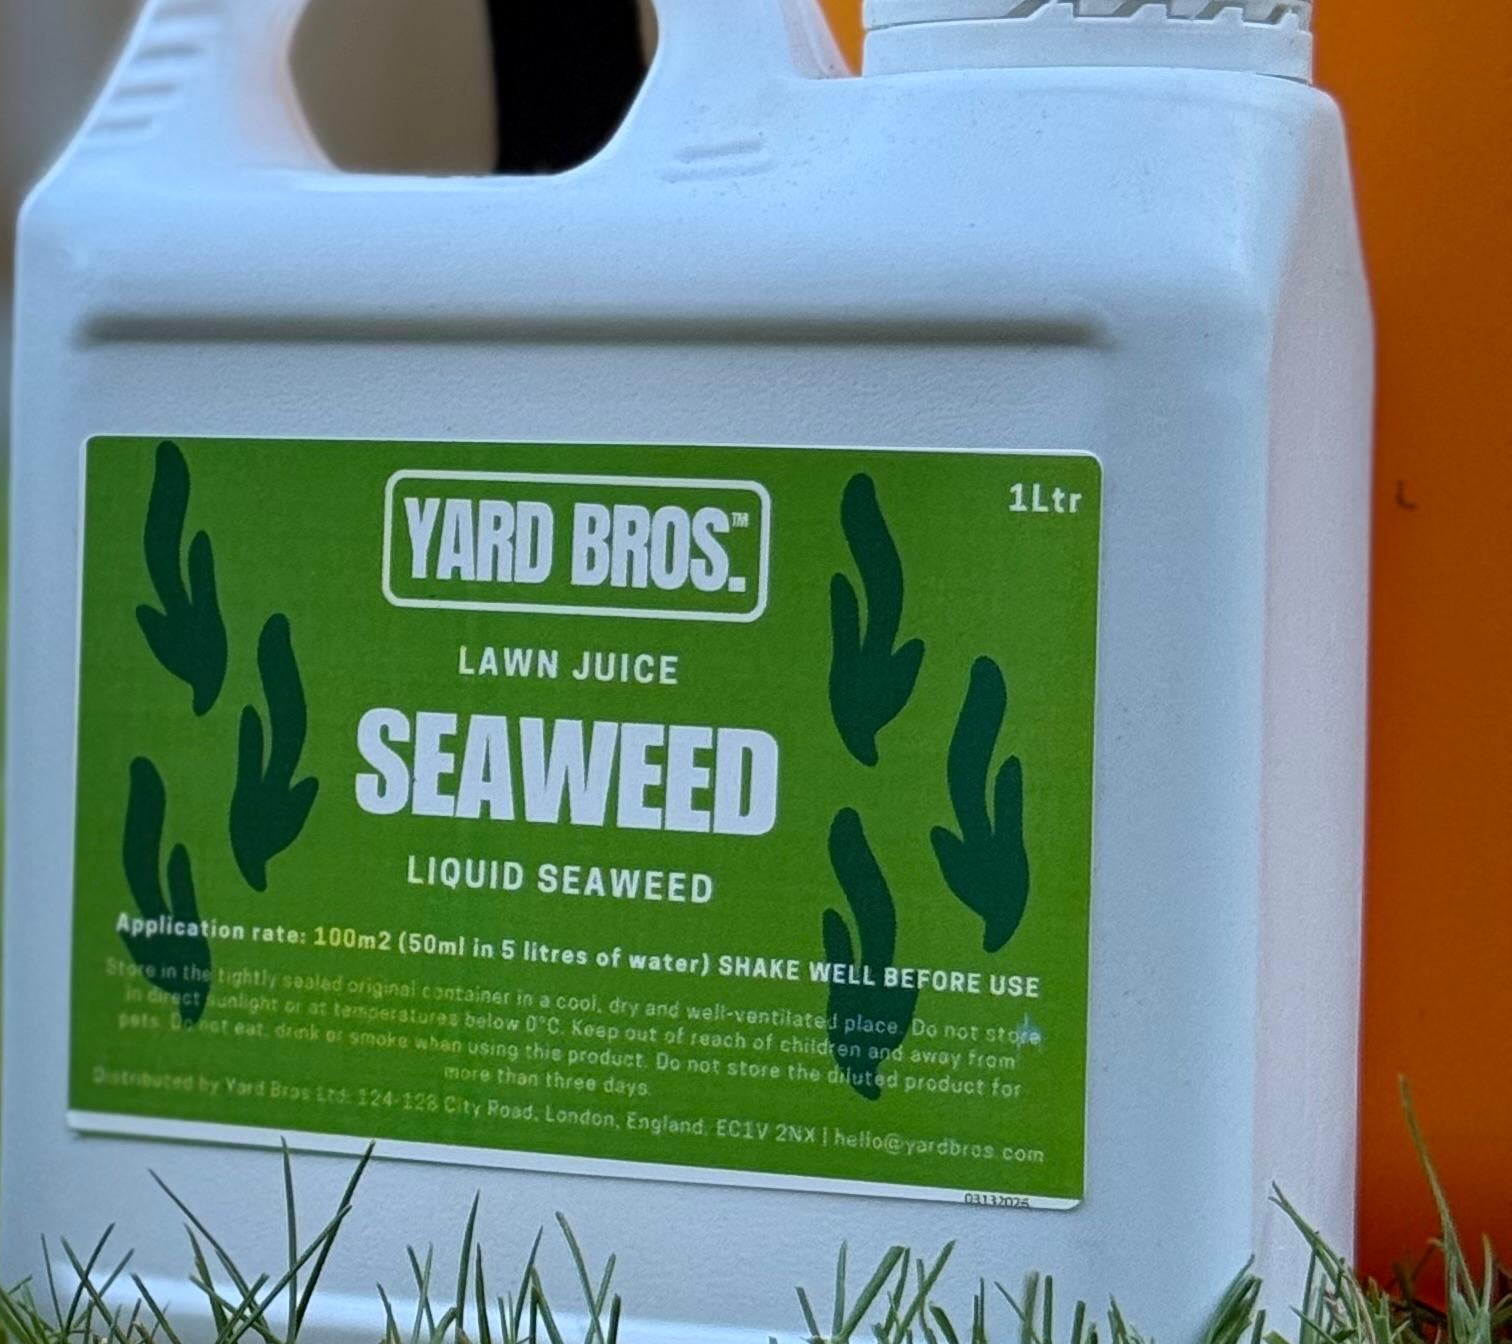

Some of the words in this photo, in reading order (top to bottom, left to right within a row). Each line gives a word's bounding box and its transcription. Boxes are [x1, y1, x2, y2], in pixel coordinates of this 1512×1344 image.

[1008, 483, 1082, 513] 1Ltr
[404, 497, 555, 583] YARD
[458, 646, 559, 679] LAWN
[572, 651, 678, 685] JUICE
[355, 708, 779, 836] SEAWEED
[407, 855, 524, 891] LIQUID
[537, 863, 713, 904] SEAWEED
[114, 912, 244, 943] Application
[251, 921, 306, 944] rate:
[312, 926, 392, 950] 100m2
[397, 932, 465, 960] (50ml
[472, 937, 494, 958] in
[500, 939, 517, 960] 5
[522, 941, 588, 965] litres
[595, 946, 623, 967] of
[627, 949, 709, 977] water)
[717, 955, 799, 980] SHAKE
[807, 962, 876, 985] WELL
[882, 967, 982, 993] BEFORE
[988, 974, 1040, 997] USE
[160, 961, 177, 979] in
[182, 963, 211, 981] the
[346, 976, 416, 1000] original
[538, 994, 550, 1007] a
[555, 991, 602, 1012] cool,
[607, 995, 639, 1018] dry
[643, 998, 679, 1017] and
[685, 1002, 837, 1027] well-ventilated
[910, 1018, 938, 1036] Do
[943, 1020, 979, 1039] not
[984, 1024, 1042, 1044] store
[464, 1011, 520, 1031] below
[570, 1019, 619, 1042] Keep
[624, 1023, 657, 1041] out
[663, 1026, 685, 1044] of
[690, 1028, 747, 1048] reach
[751, 1033, 774, 1050] of
[779, 1035, 860, 1056] children
[867, 1042, 904, 1060] and
[909, 1049, 961, 1068] away
[967, 1049, 1016, 1069] from
[467, 1037, 519, 1060] using
[655, 1052, 681, 1070] Do
[687, 1055, 720, 1073] not
[726, 1058, 780, 1078] store
[787, 1063, 820, 1081] the
[903, 1072, 985, 1097] product
[990, 1079, 1023, 1097] for
[443, 1066, 490, 1082] more
[496, 1067, 538, 1086] than
[545, 1071, 595, 1091] three
[716, 1118, 769, 1139] EC1V
[774, 1123, 815, 1143] 2NX
